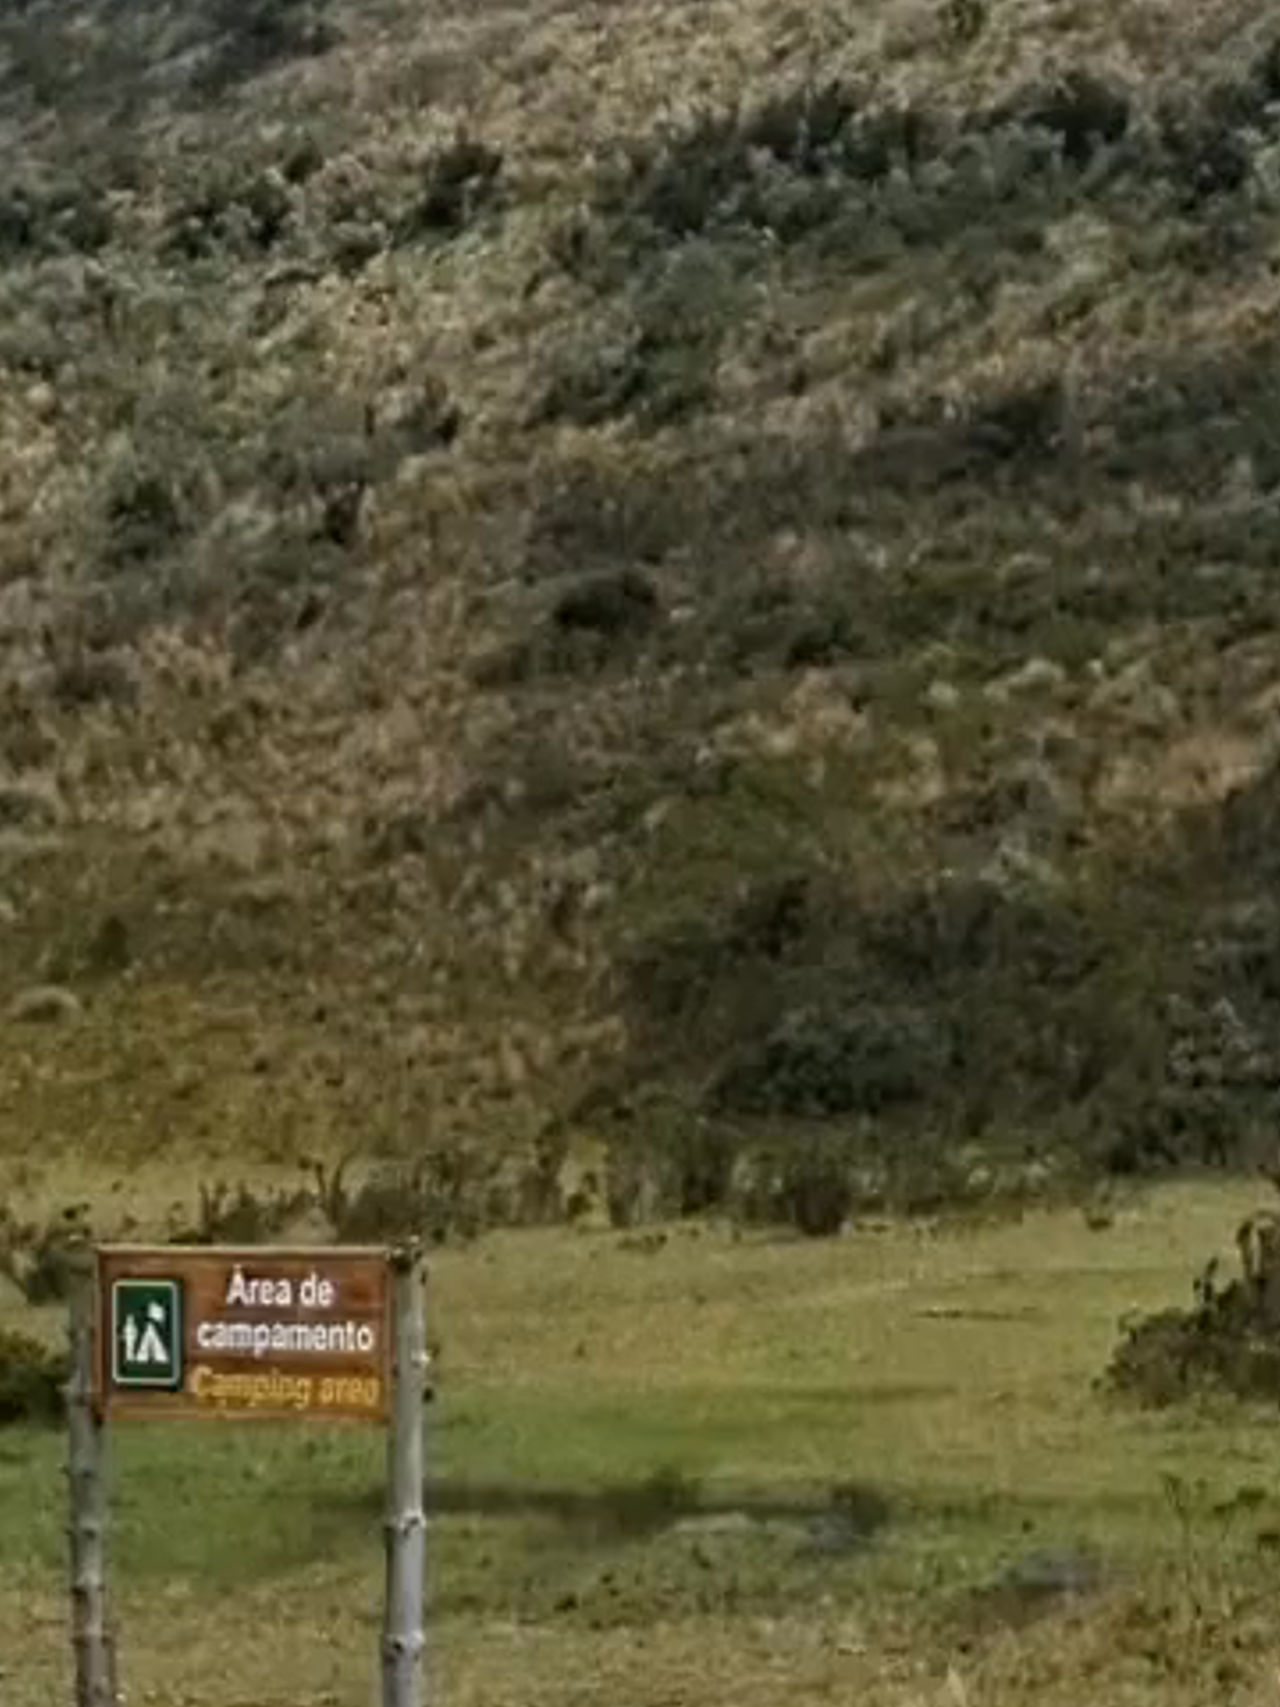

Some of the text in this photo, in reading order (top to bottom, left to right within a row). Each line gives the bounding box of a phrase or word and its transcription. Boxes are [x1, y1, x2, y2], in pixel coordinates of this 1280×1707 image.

[300, 1272, 334, 1307] de
[196, 1320, 374, 1357] campamento
[191, 1365, 380, 1408] Camping area
